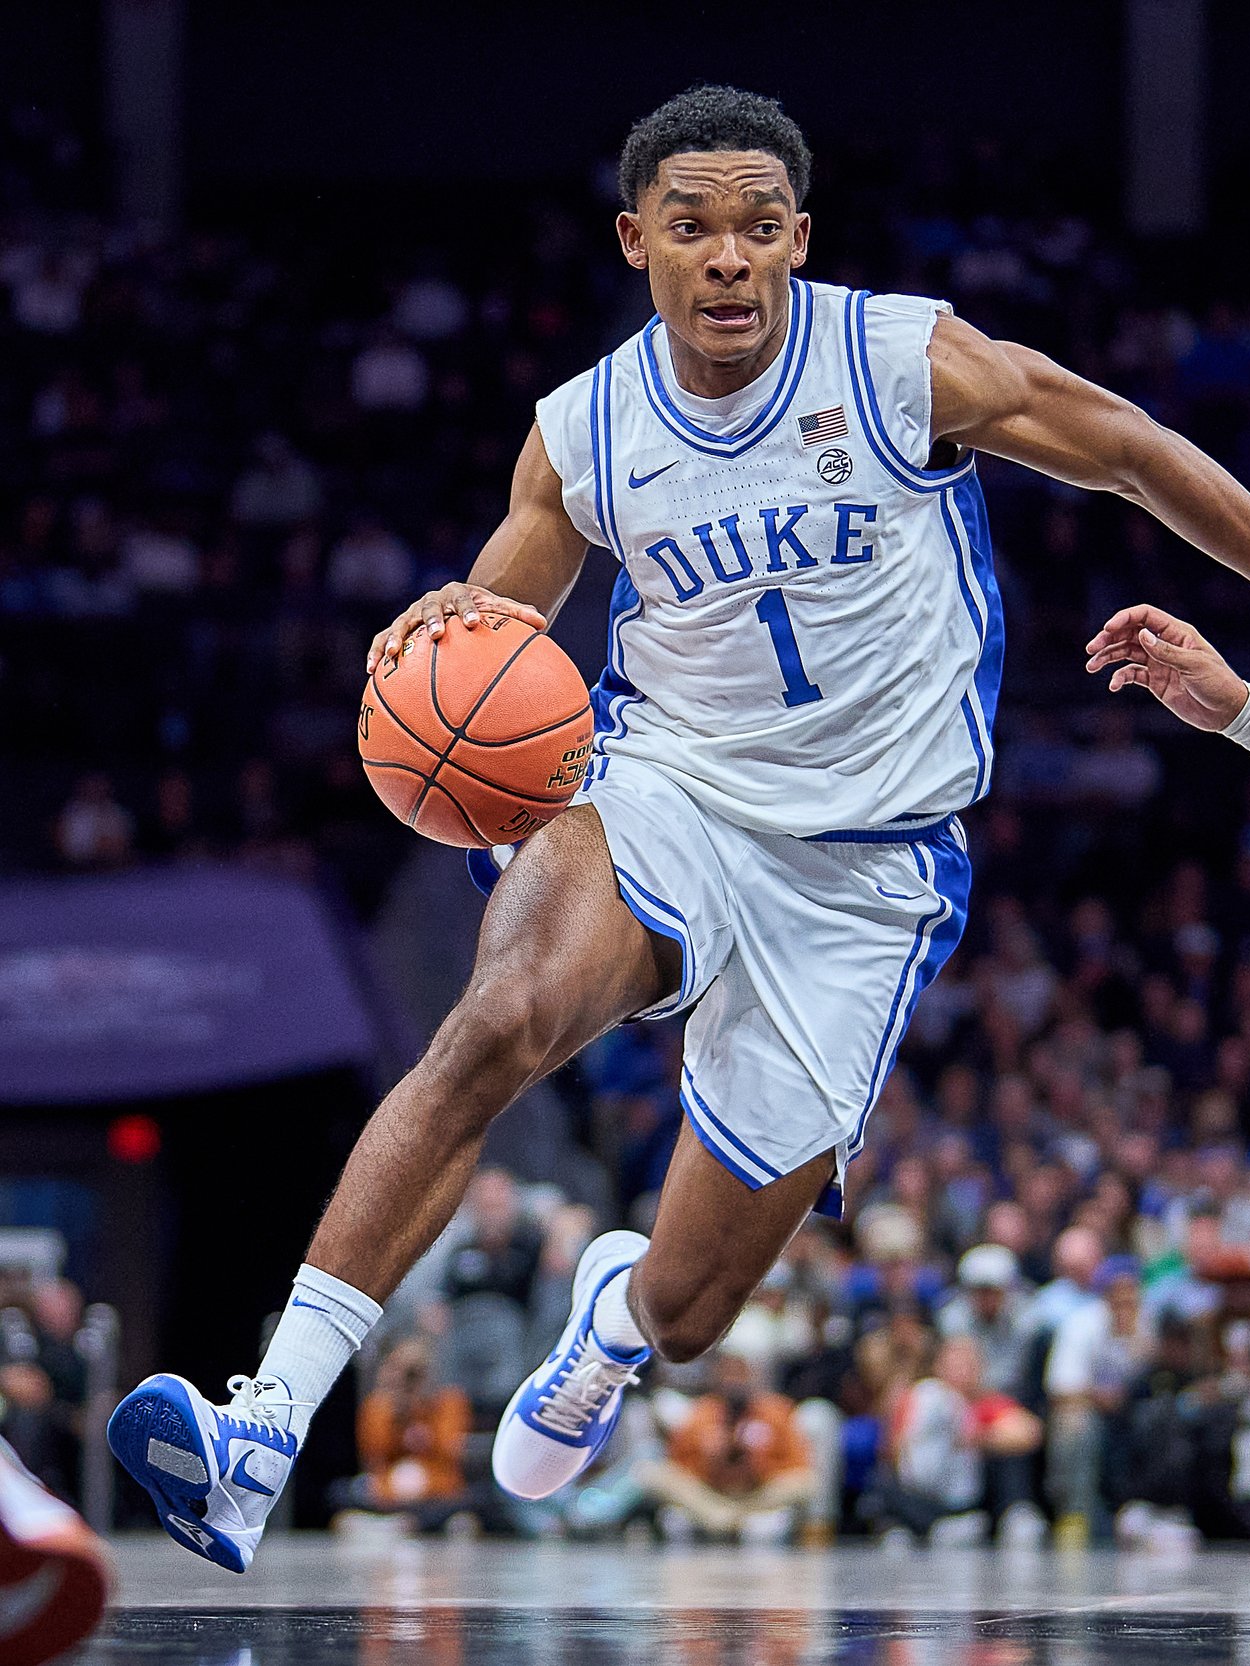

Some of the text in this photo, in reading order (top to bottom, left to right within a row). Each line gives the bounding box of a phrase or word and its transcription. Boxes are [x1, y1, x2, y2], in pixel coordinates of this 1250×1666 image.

[821, 456, 849, 472] ACC
[645, 502, 878, 604] DUKE
[755, 587, 823, 708] 1
